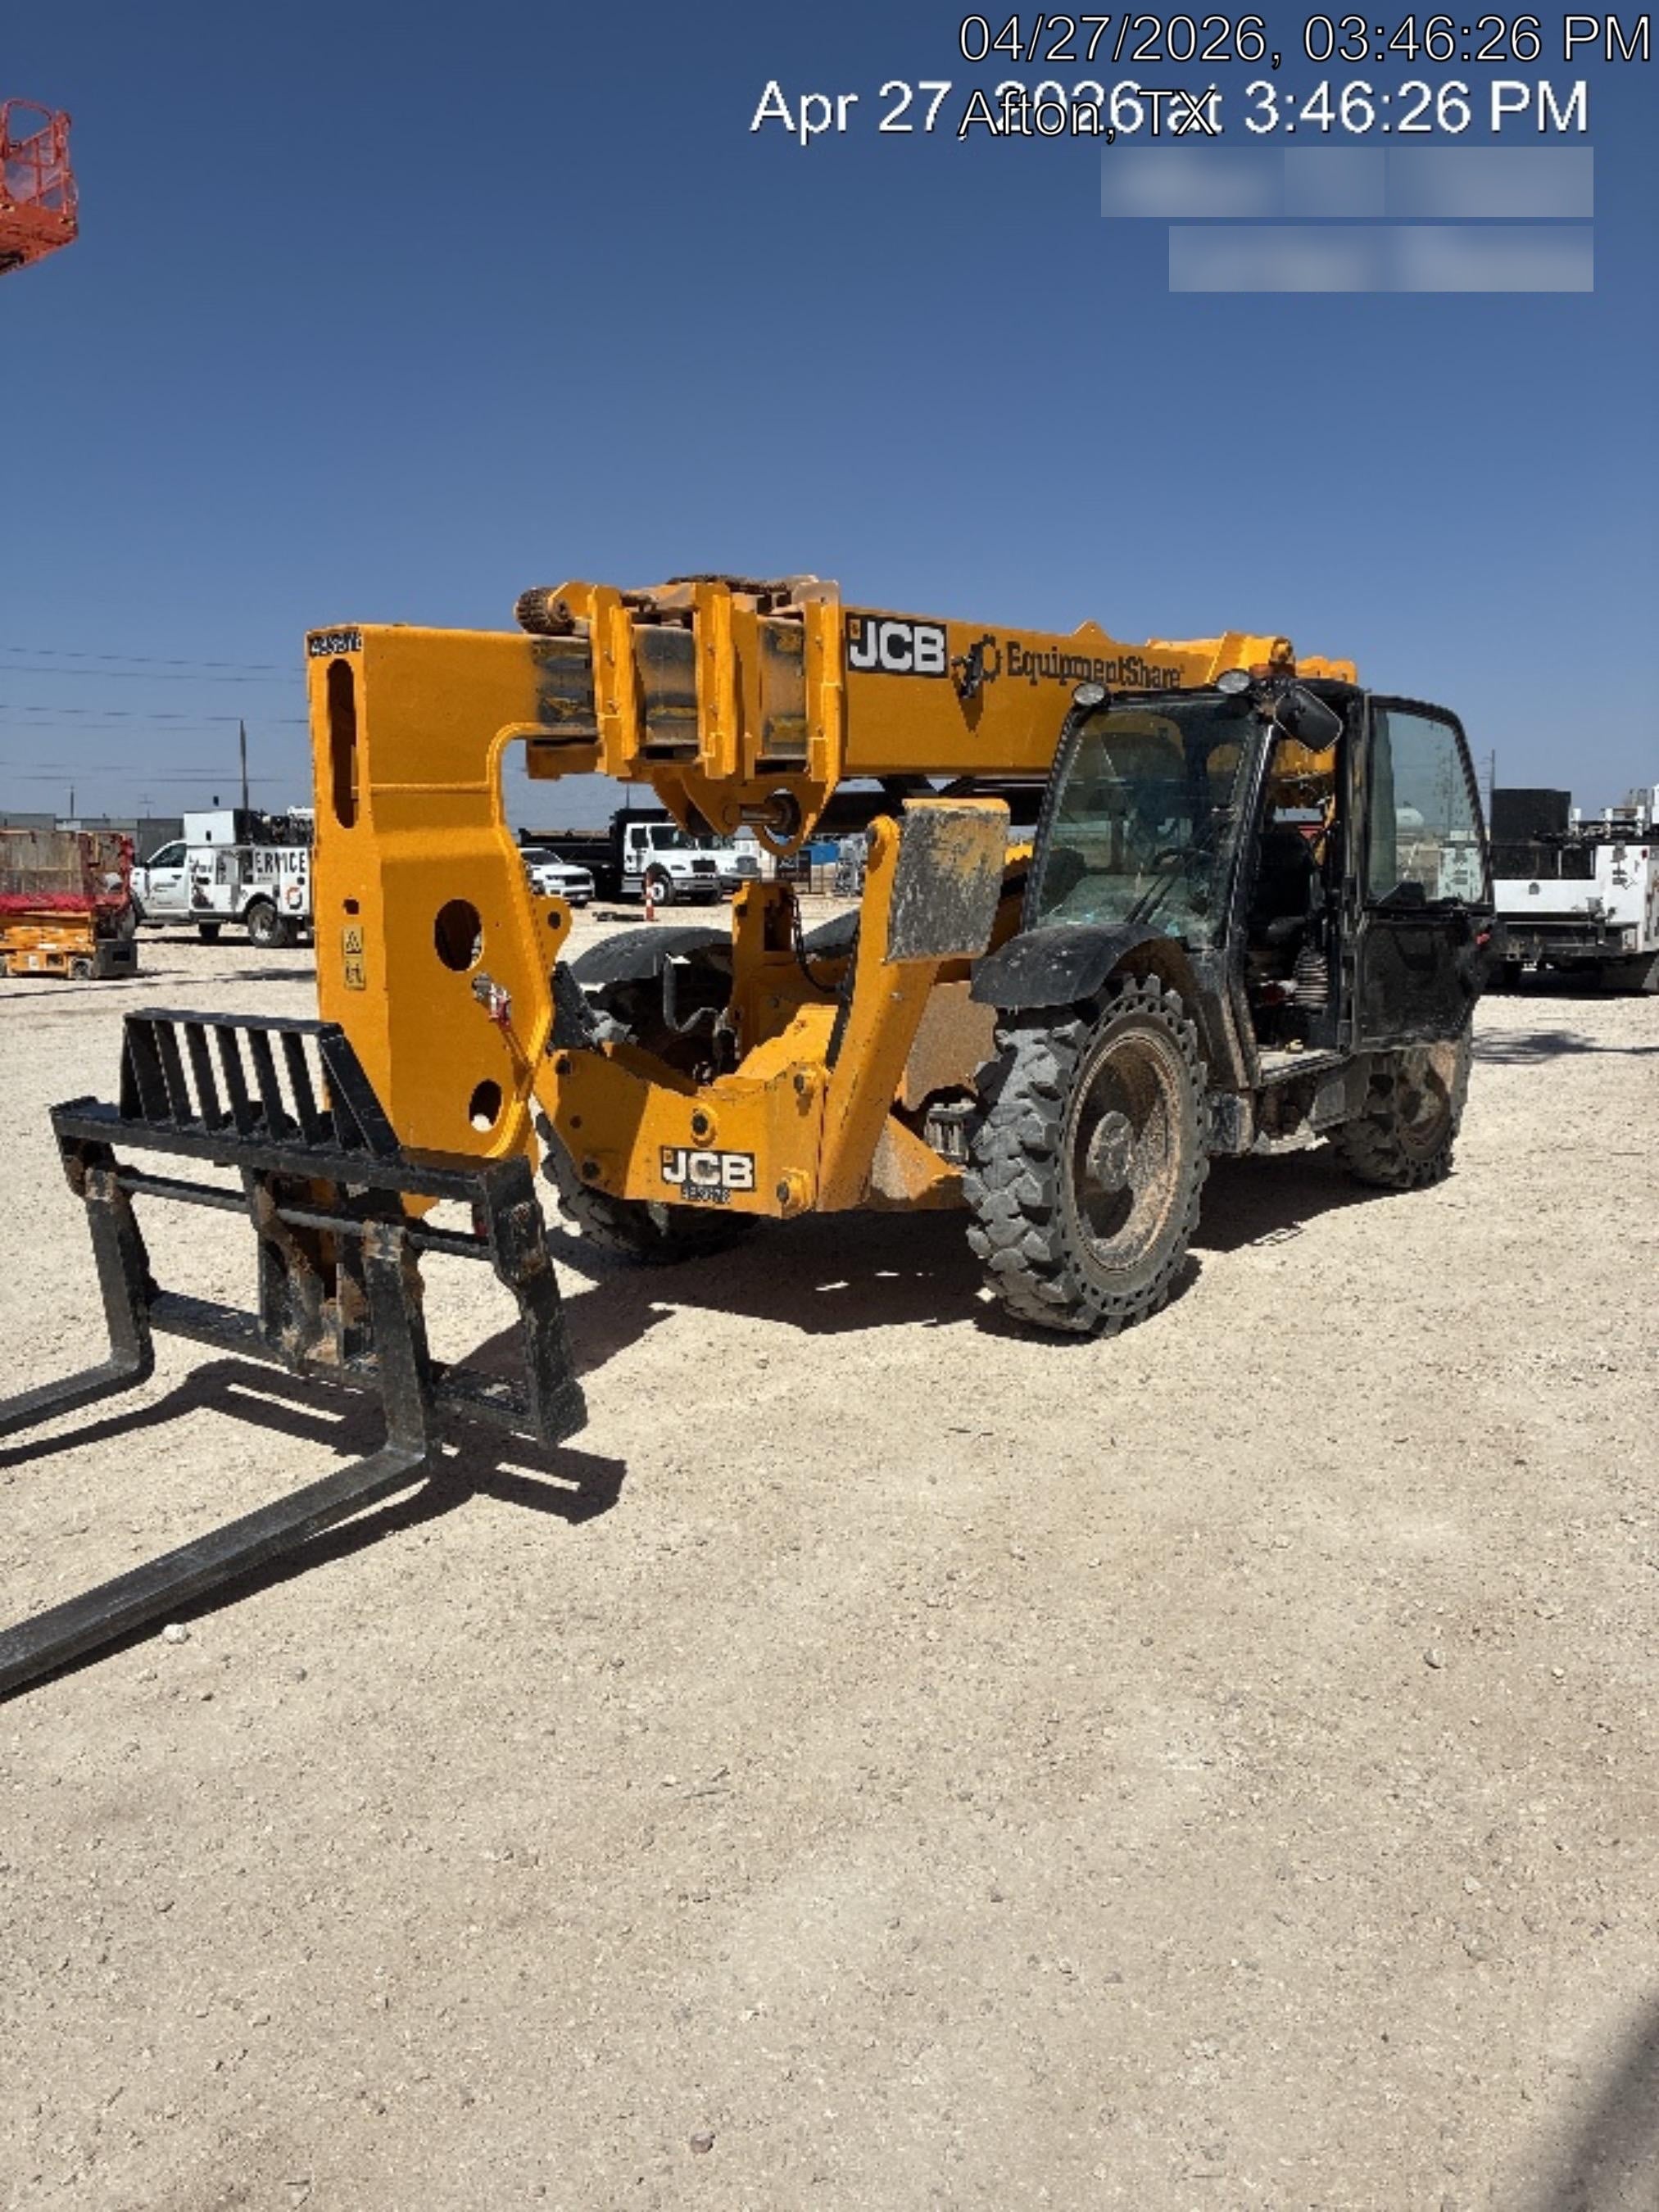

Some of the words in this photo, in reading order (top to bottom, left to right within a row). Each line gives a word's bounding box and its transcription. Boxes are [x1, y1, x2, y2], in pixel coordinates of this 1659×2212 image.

[850, 621, 945, 673] JCB
[1007, 641, 1181, 689] EquipmentShare
[663, 1149, 753, 1189] JCB
